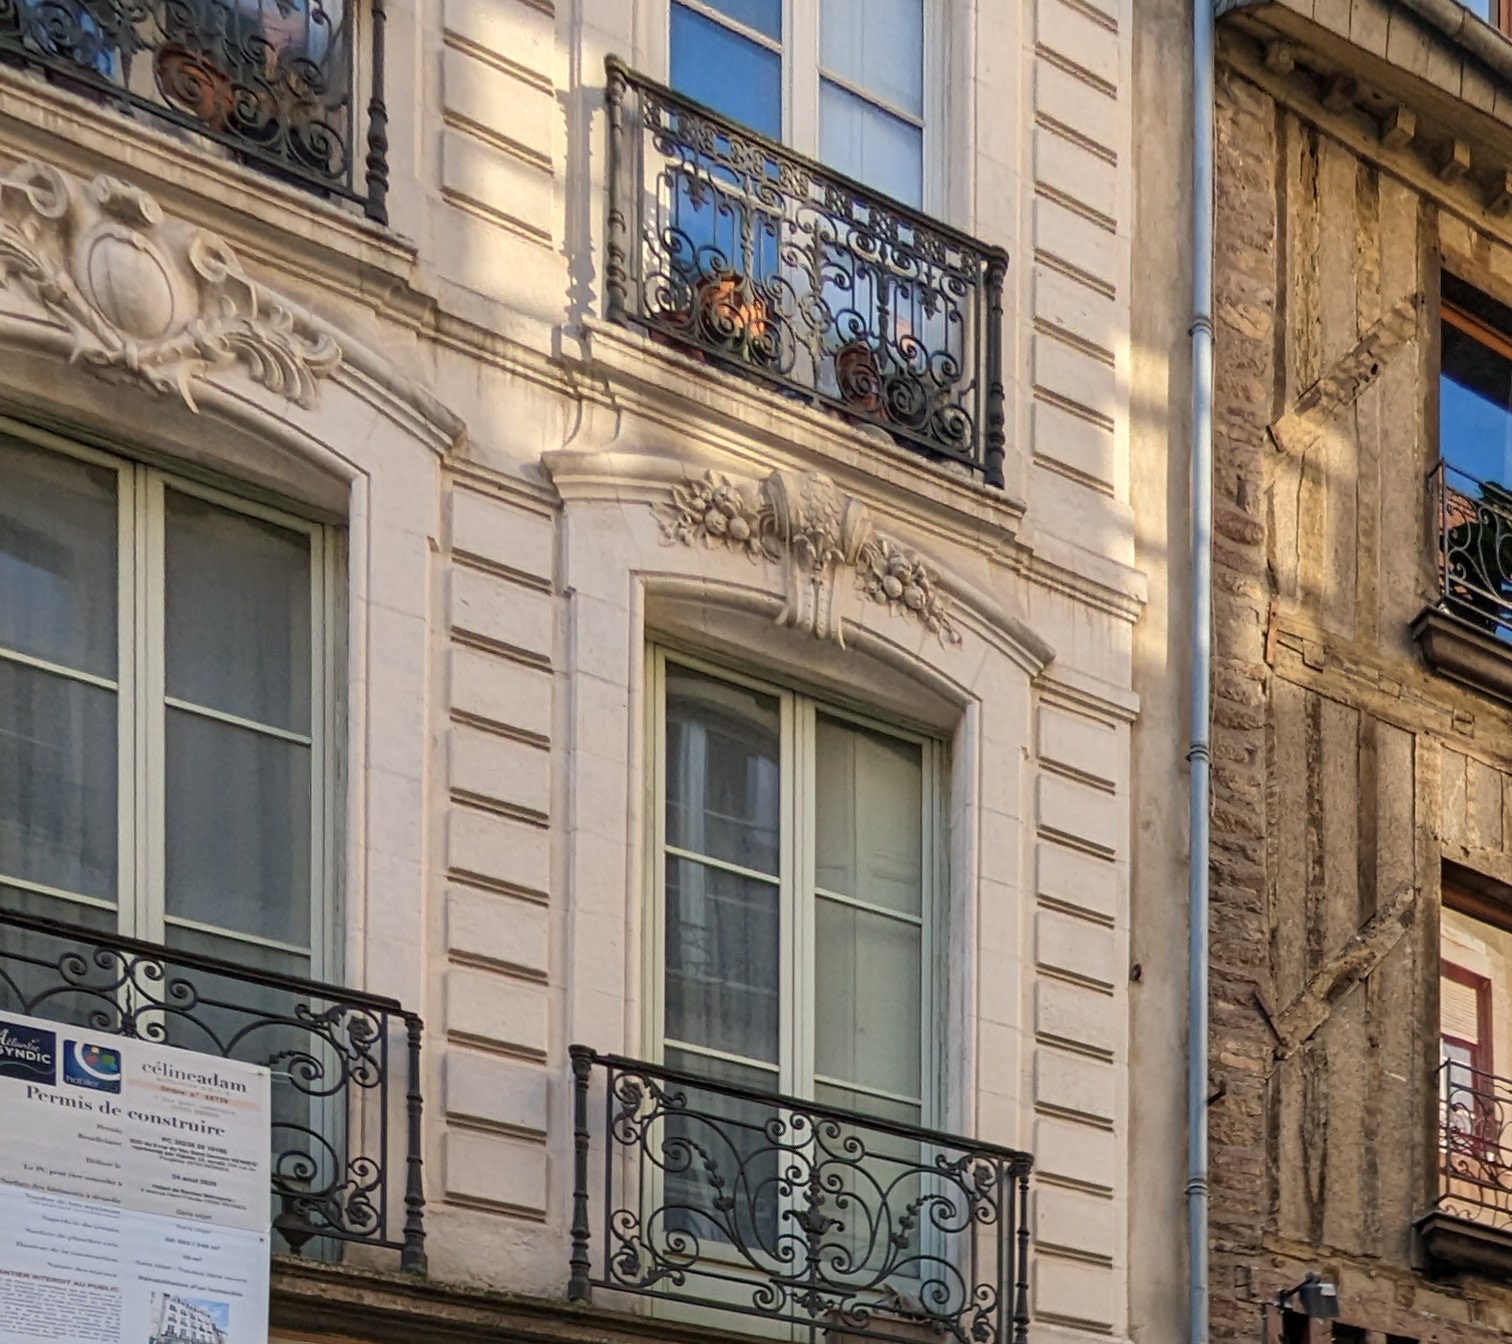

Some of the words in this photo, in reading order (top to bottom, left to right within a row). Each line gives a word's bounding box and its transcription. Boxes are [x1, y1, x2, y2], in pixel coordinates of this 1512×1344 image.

[142, 1061, 247, 1093] célineadam
[26, 1085, 94, 1112] Permis
[99, 1098, 122, 1116] de
[127, 1109, 226, 1137] construire
